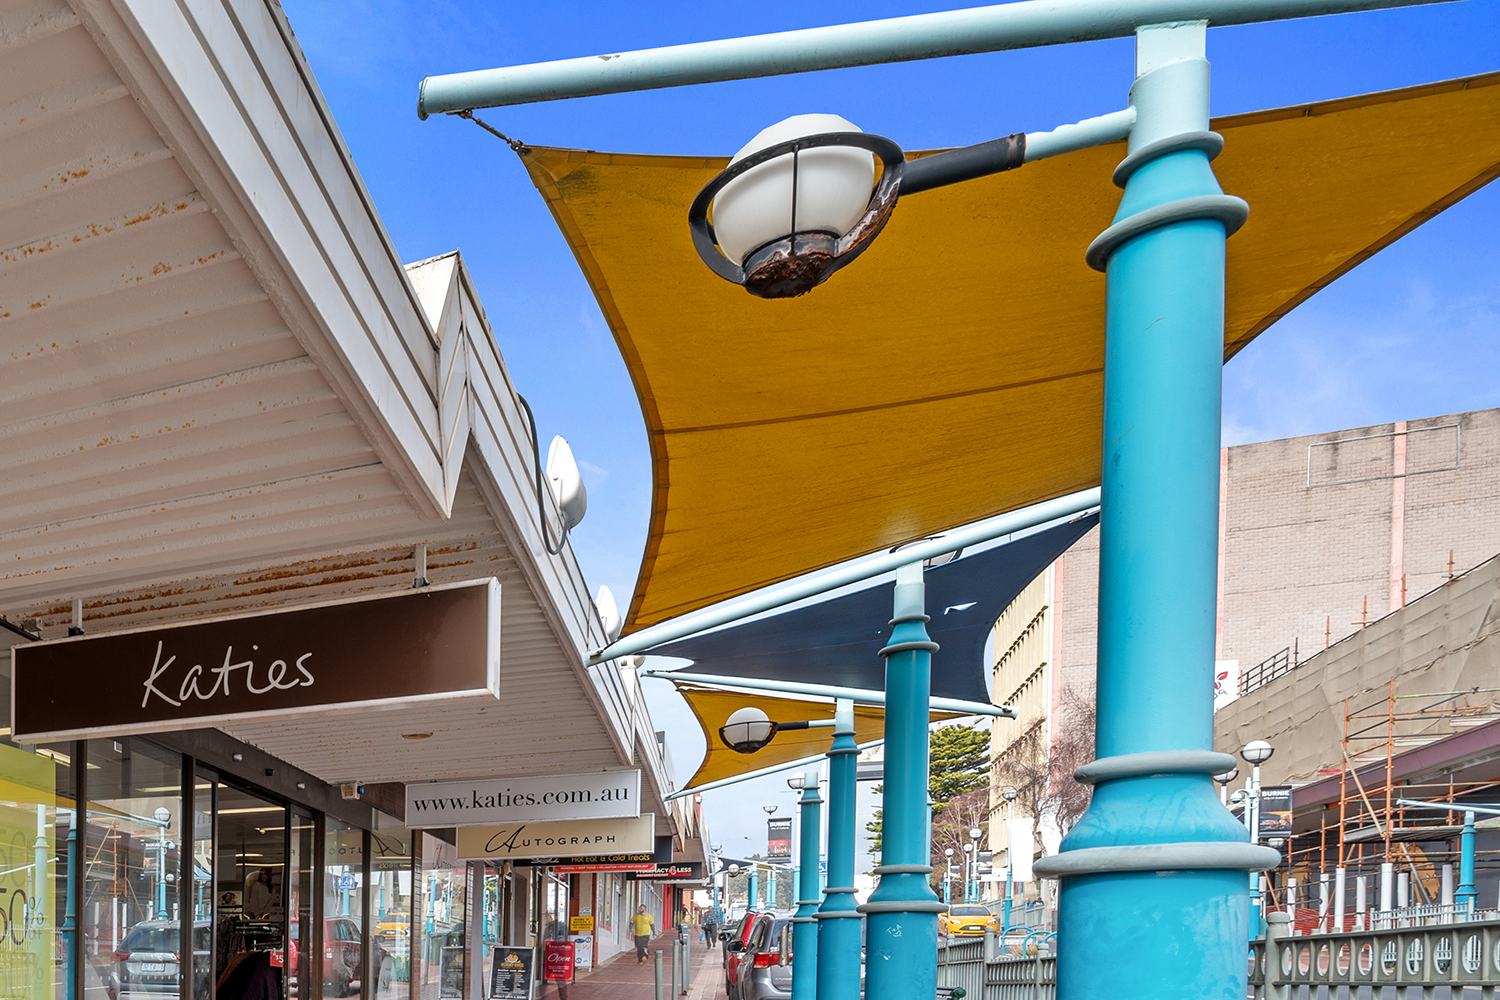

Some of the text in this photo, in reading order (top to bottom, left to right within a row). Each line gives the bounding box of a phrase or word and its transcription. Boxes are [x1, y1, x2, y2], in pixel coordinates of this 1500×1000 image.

[142, 640, 315, 708] Katies
[413, 787, 629, 812] www.katies.com.au
[485, 825, 616, 853] AUTOGRAPH
[608, 854, 625, 862] Cold
[627, 853, 651, 861] Treats
[547, 952, 571, 963] Open
